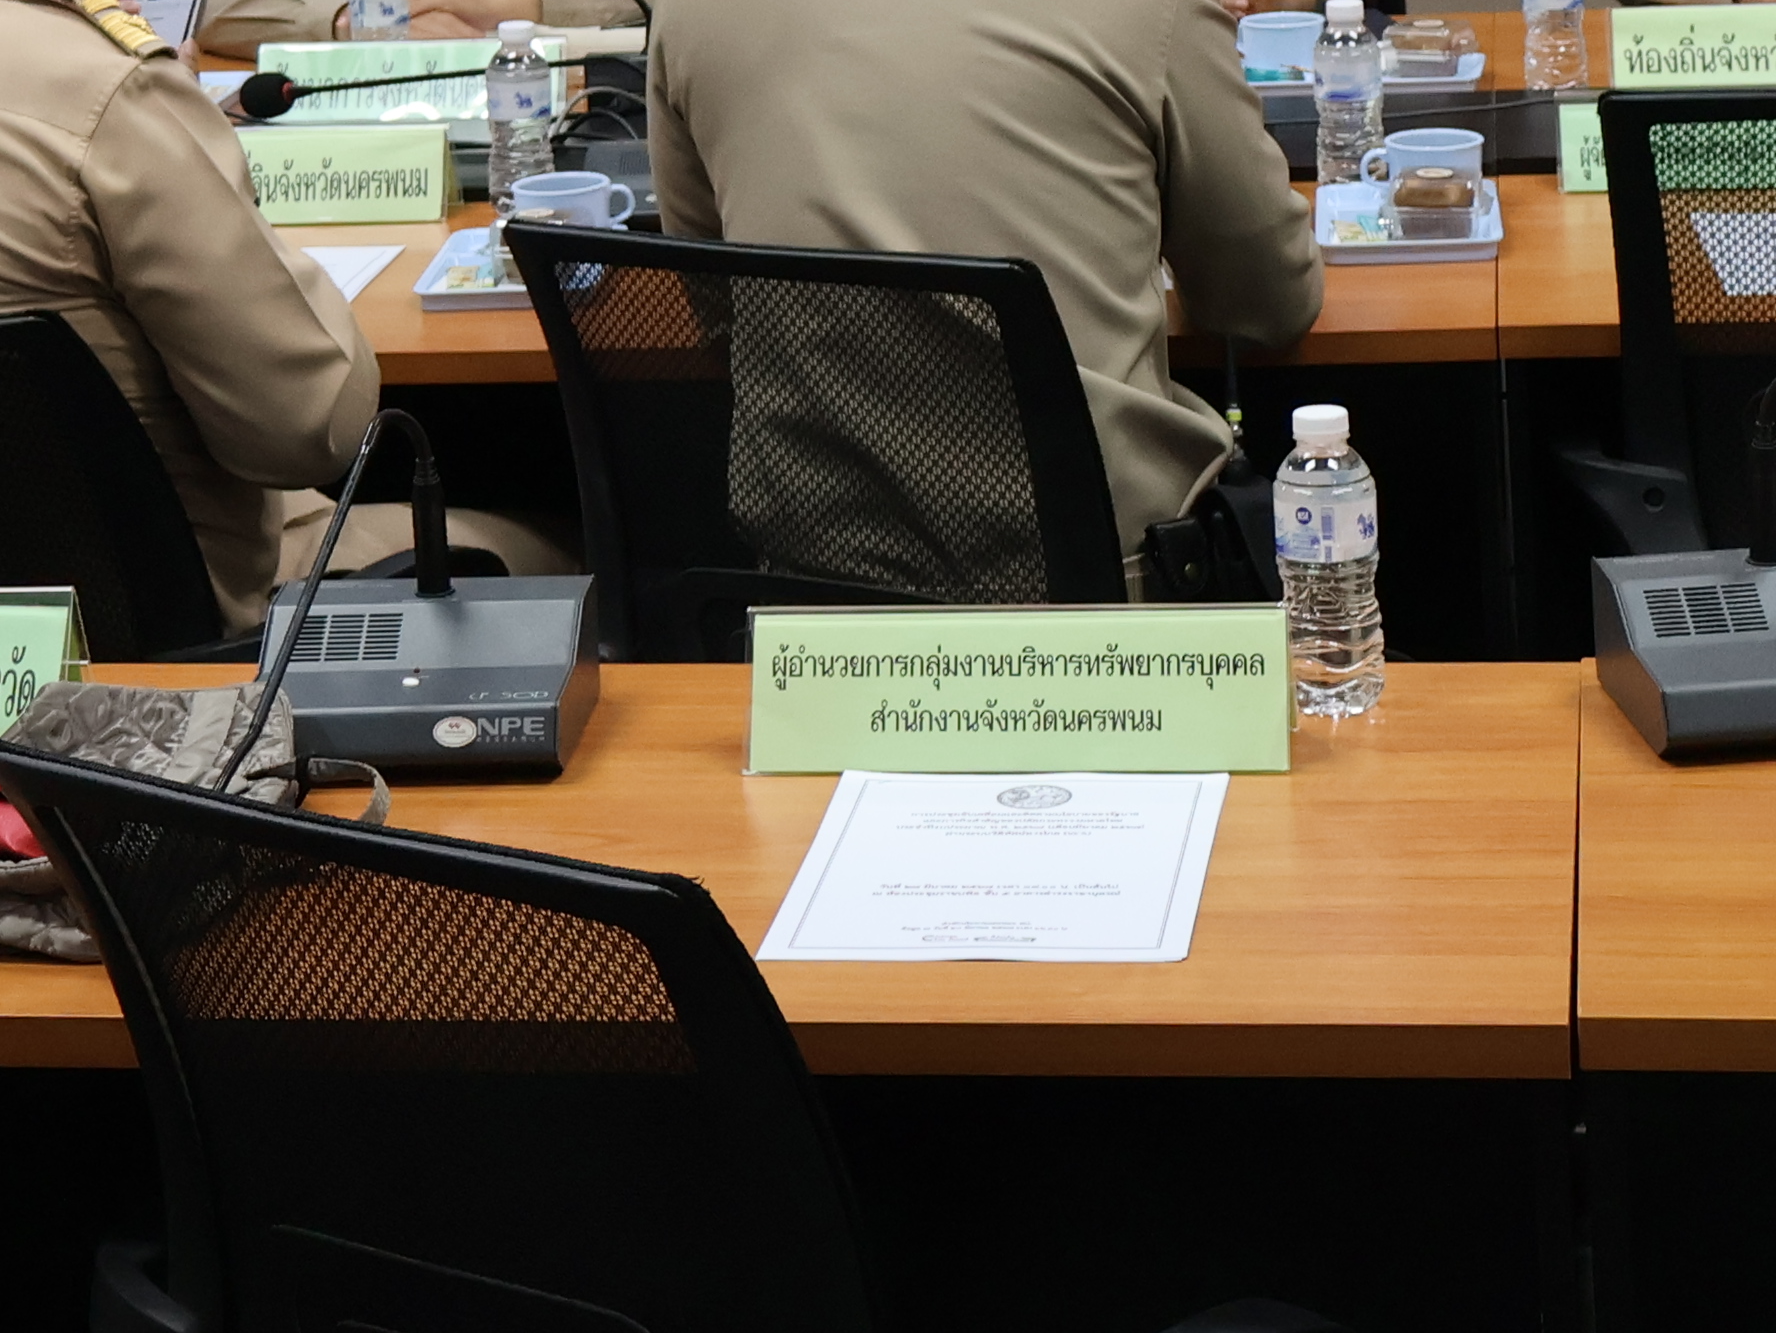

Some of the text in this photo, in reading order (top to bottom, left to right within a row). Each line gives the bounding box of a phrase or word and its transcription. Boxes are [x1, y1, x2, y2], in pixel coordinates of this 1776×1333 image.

[247, 150, 429, 204] ดินจังหวัดนครพนม
[770, 643, 1266, 691] ผู้อำนวยการกลุ่มงานบริหารทรัพยากรบุคคล
[477, 716, 545, 736] NPE
[870, 698, 1164, 734] สำนักงานจังหวัดนครพนม
